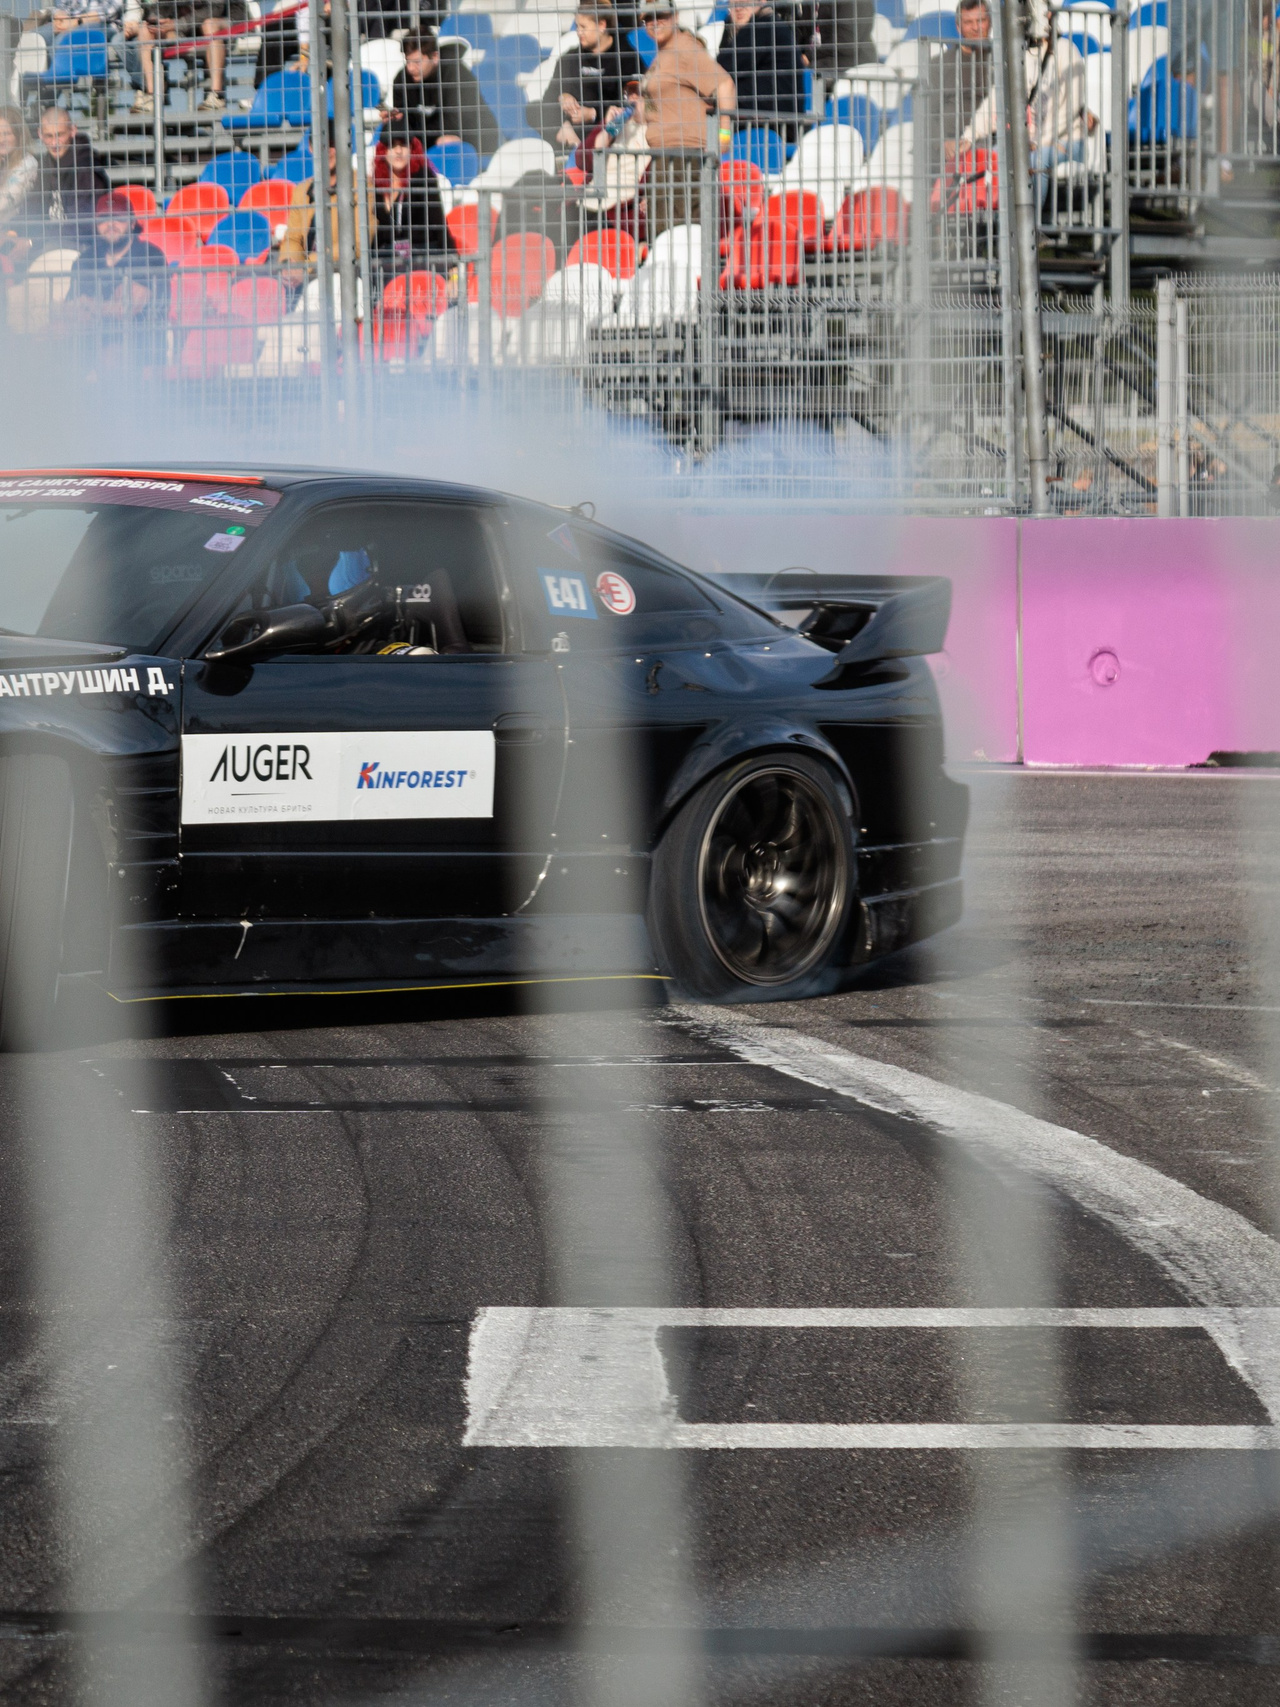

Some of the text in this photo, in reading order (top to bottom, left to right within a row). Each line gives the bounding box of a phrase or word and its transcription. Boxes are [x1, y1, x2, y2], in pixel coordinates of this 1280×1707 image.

[17, 478, 185, 493] САНКТ-ПЕТЕРБУРГА
[41, 488, 86, 497] 2026
[146, 667, 175, 696] Д.
[209, 743, 314, 783] AUGER
[207, 804, 313, 815] НОВАЯ КУЛЬТУРА БРИТЬЯ
